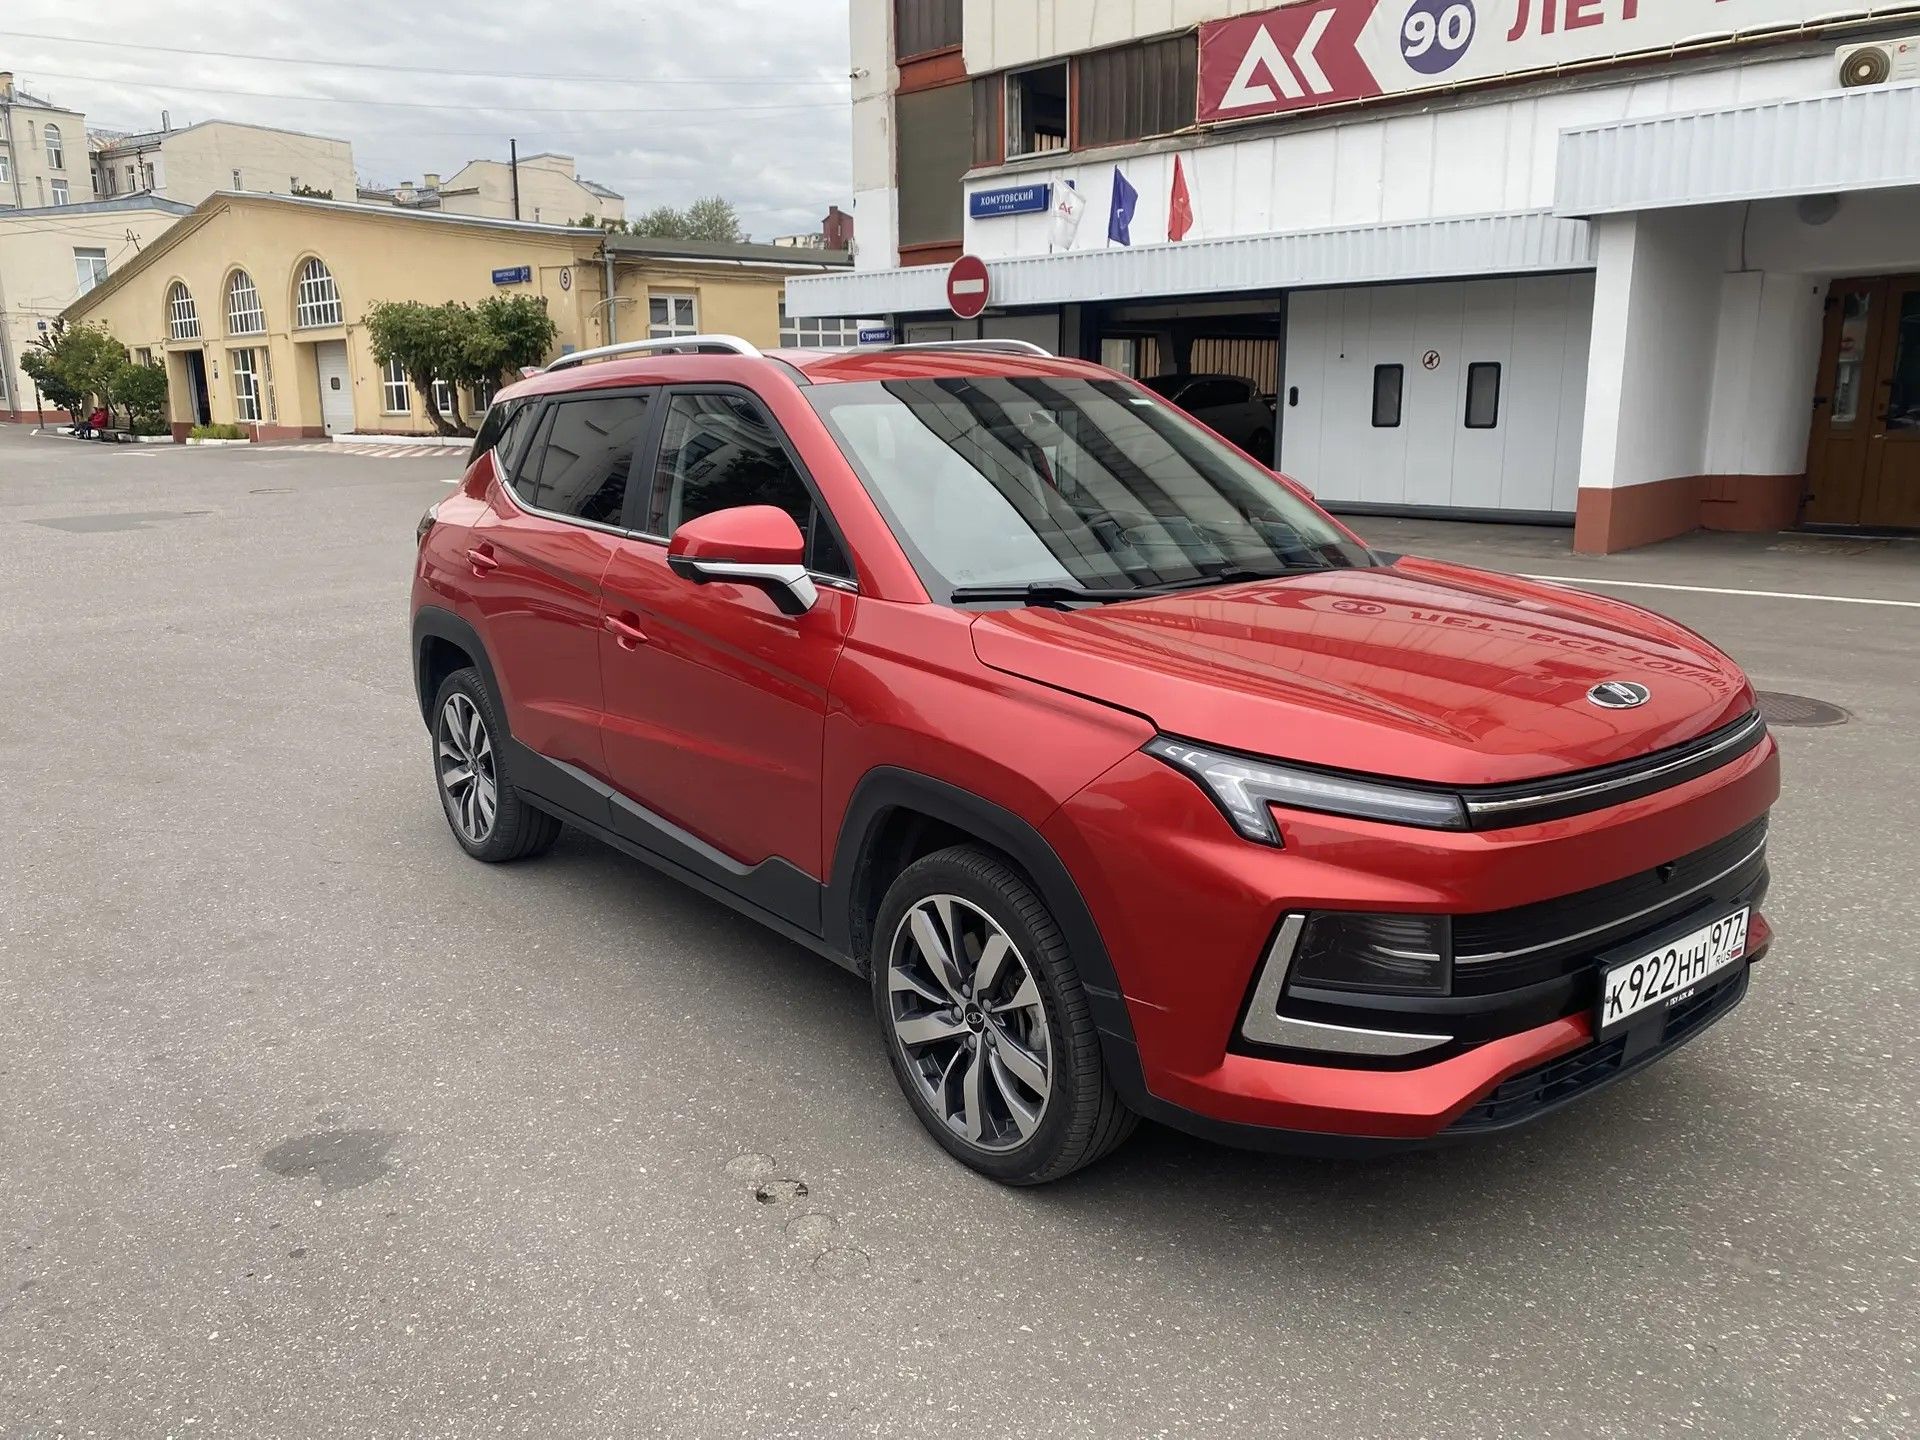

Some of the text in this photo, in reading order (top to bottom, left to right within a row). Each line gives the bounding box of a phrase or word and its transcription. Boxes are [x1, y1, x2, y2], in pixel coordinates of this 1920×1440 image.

[1404, 4, 1472, 57] 90
[981, 189, 1034, 206] ХОМУТОВСКИЙ
[1610, 912, 1744, 1018] К922НН 977
[1716, 949, 1731, 966] RUS
